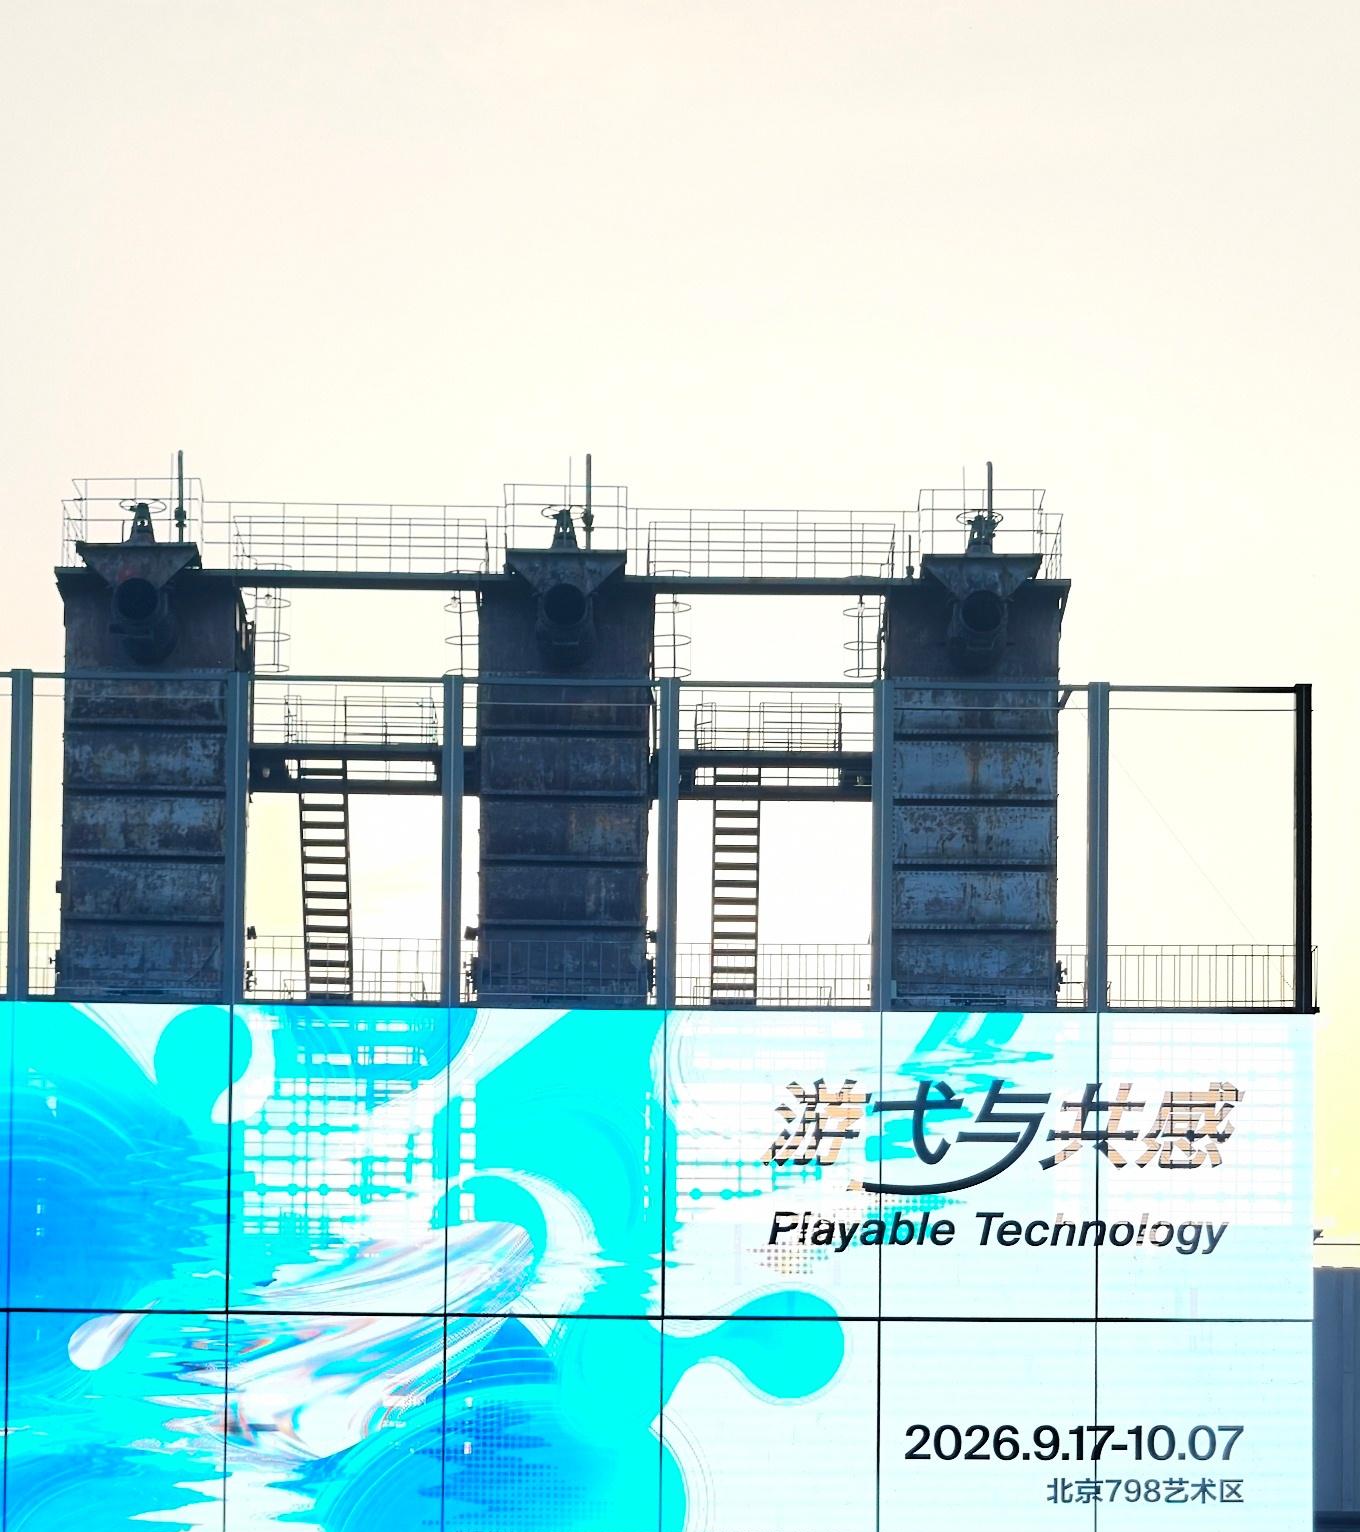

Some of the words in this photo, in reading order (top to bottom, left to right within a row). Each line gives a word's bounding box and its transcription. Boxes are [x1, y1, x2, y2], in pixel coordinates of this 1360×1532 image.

[760, 1079, 1245, 1195] 游弋与共感
[768, 1211, 956, 1250] Playable
[975, 1211, 1230, 1255] Technology
[904, 1424, 1245, 1461] 2026.9.17-10.07
[1046, 1477, 1245, 1504] 北京798艺术区
